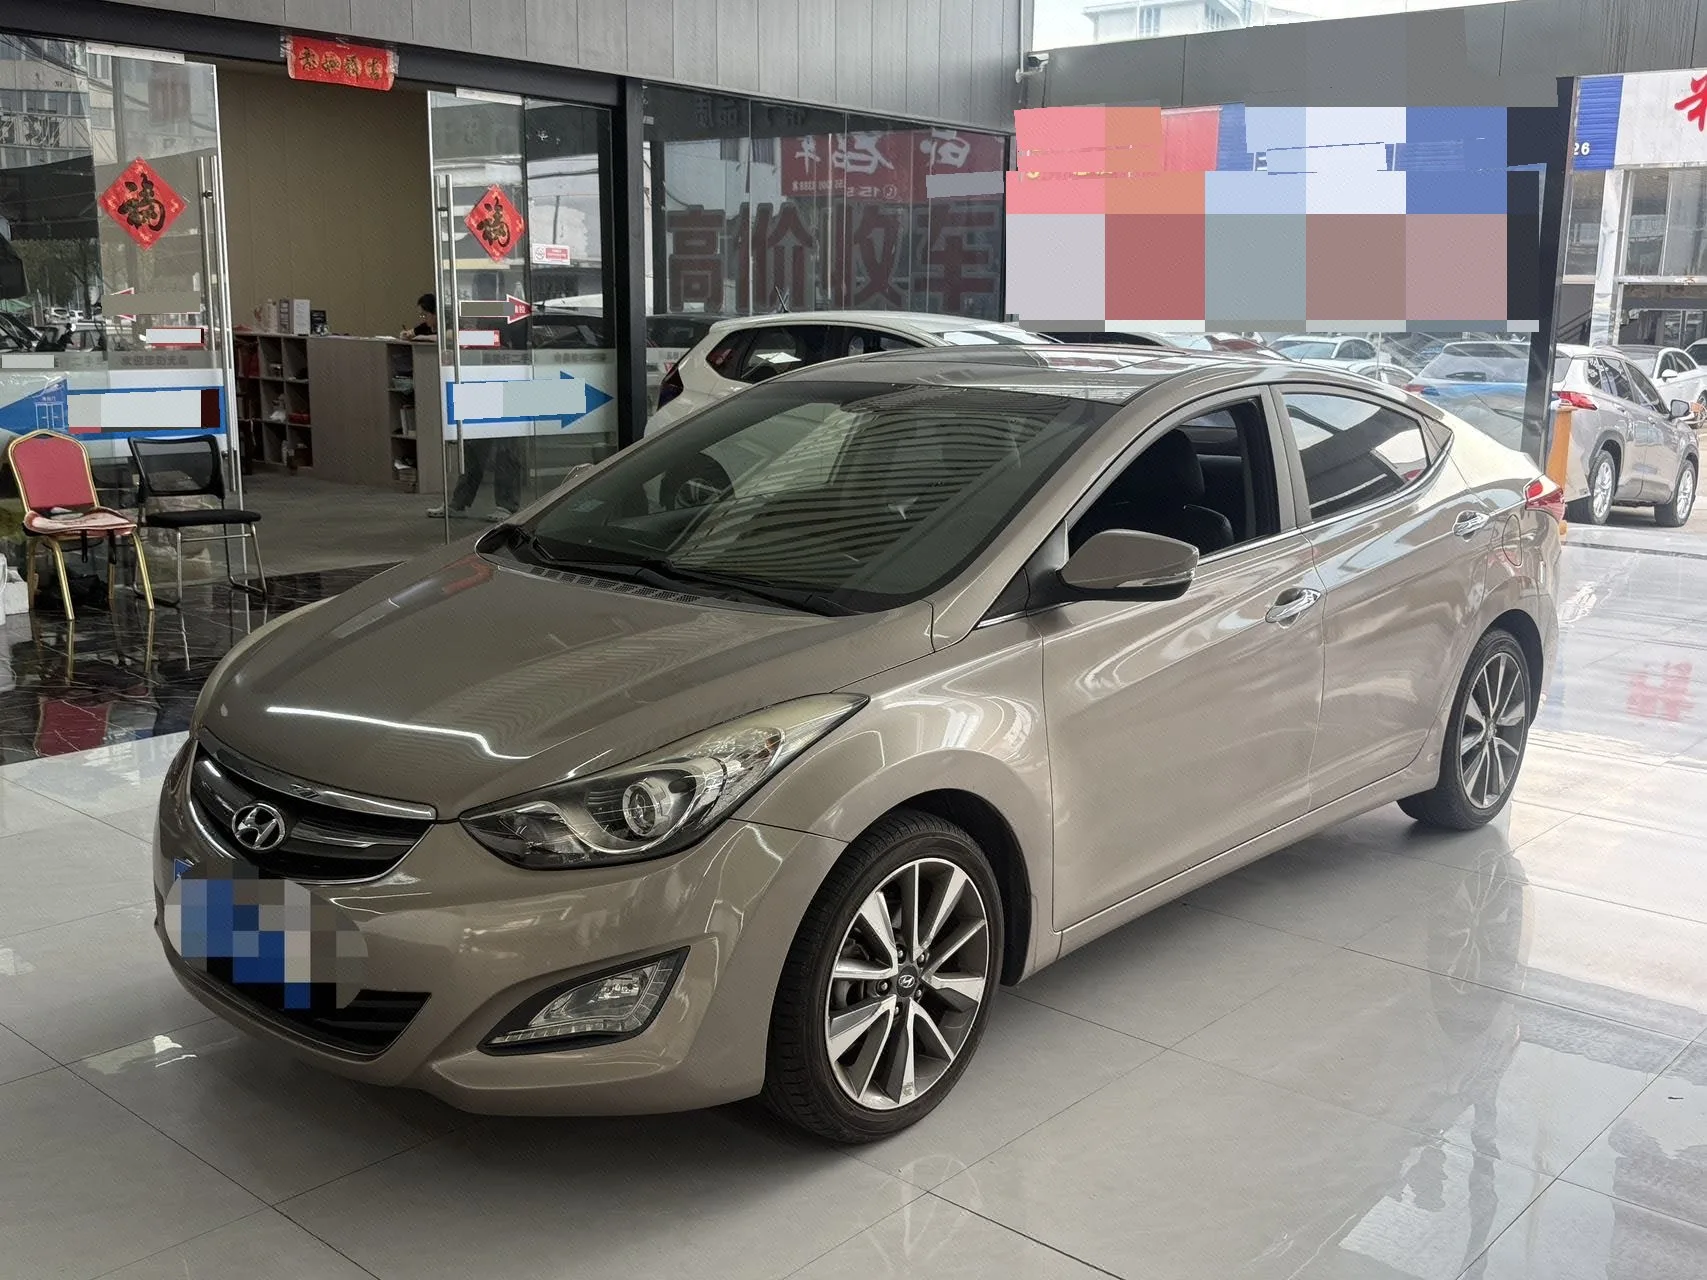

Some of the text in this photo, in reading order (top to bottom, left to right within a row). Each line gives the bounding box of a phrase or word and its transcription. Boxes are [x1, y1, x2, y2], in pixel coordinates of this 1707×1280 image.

[117, 172, 166, 232] 福
[476, 196, 511, 248] 福
[667, 203, 998, 313] 高价收车
